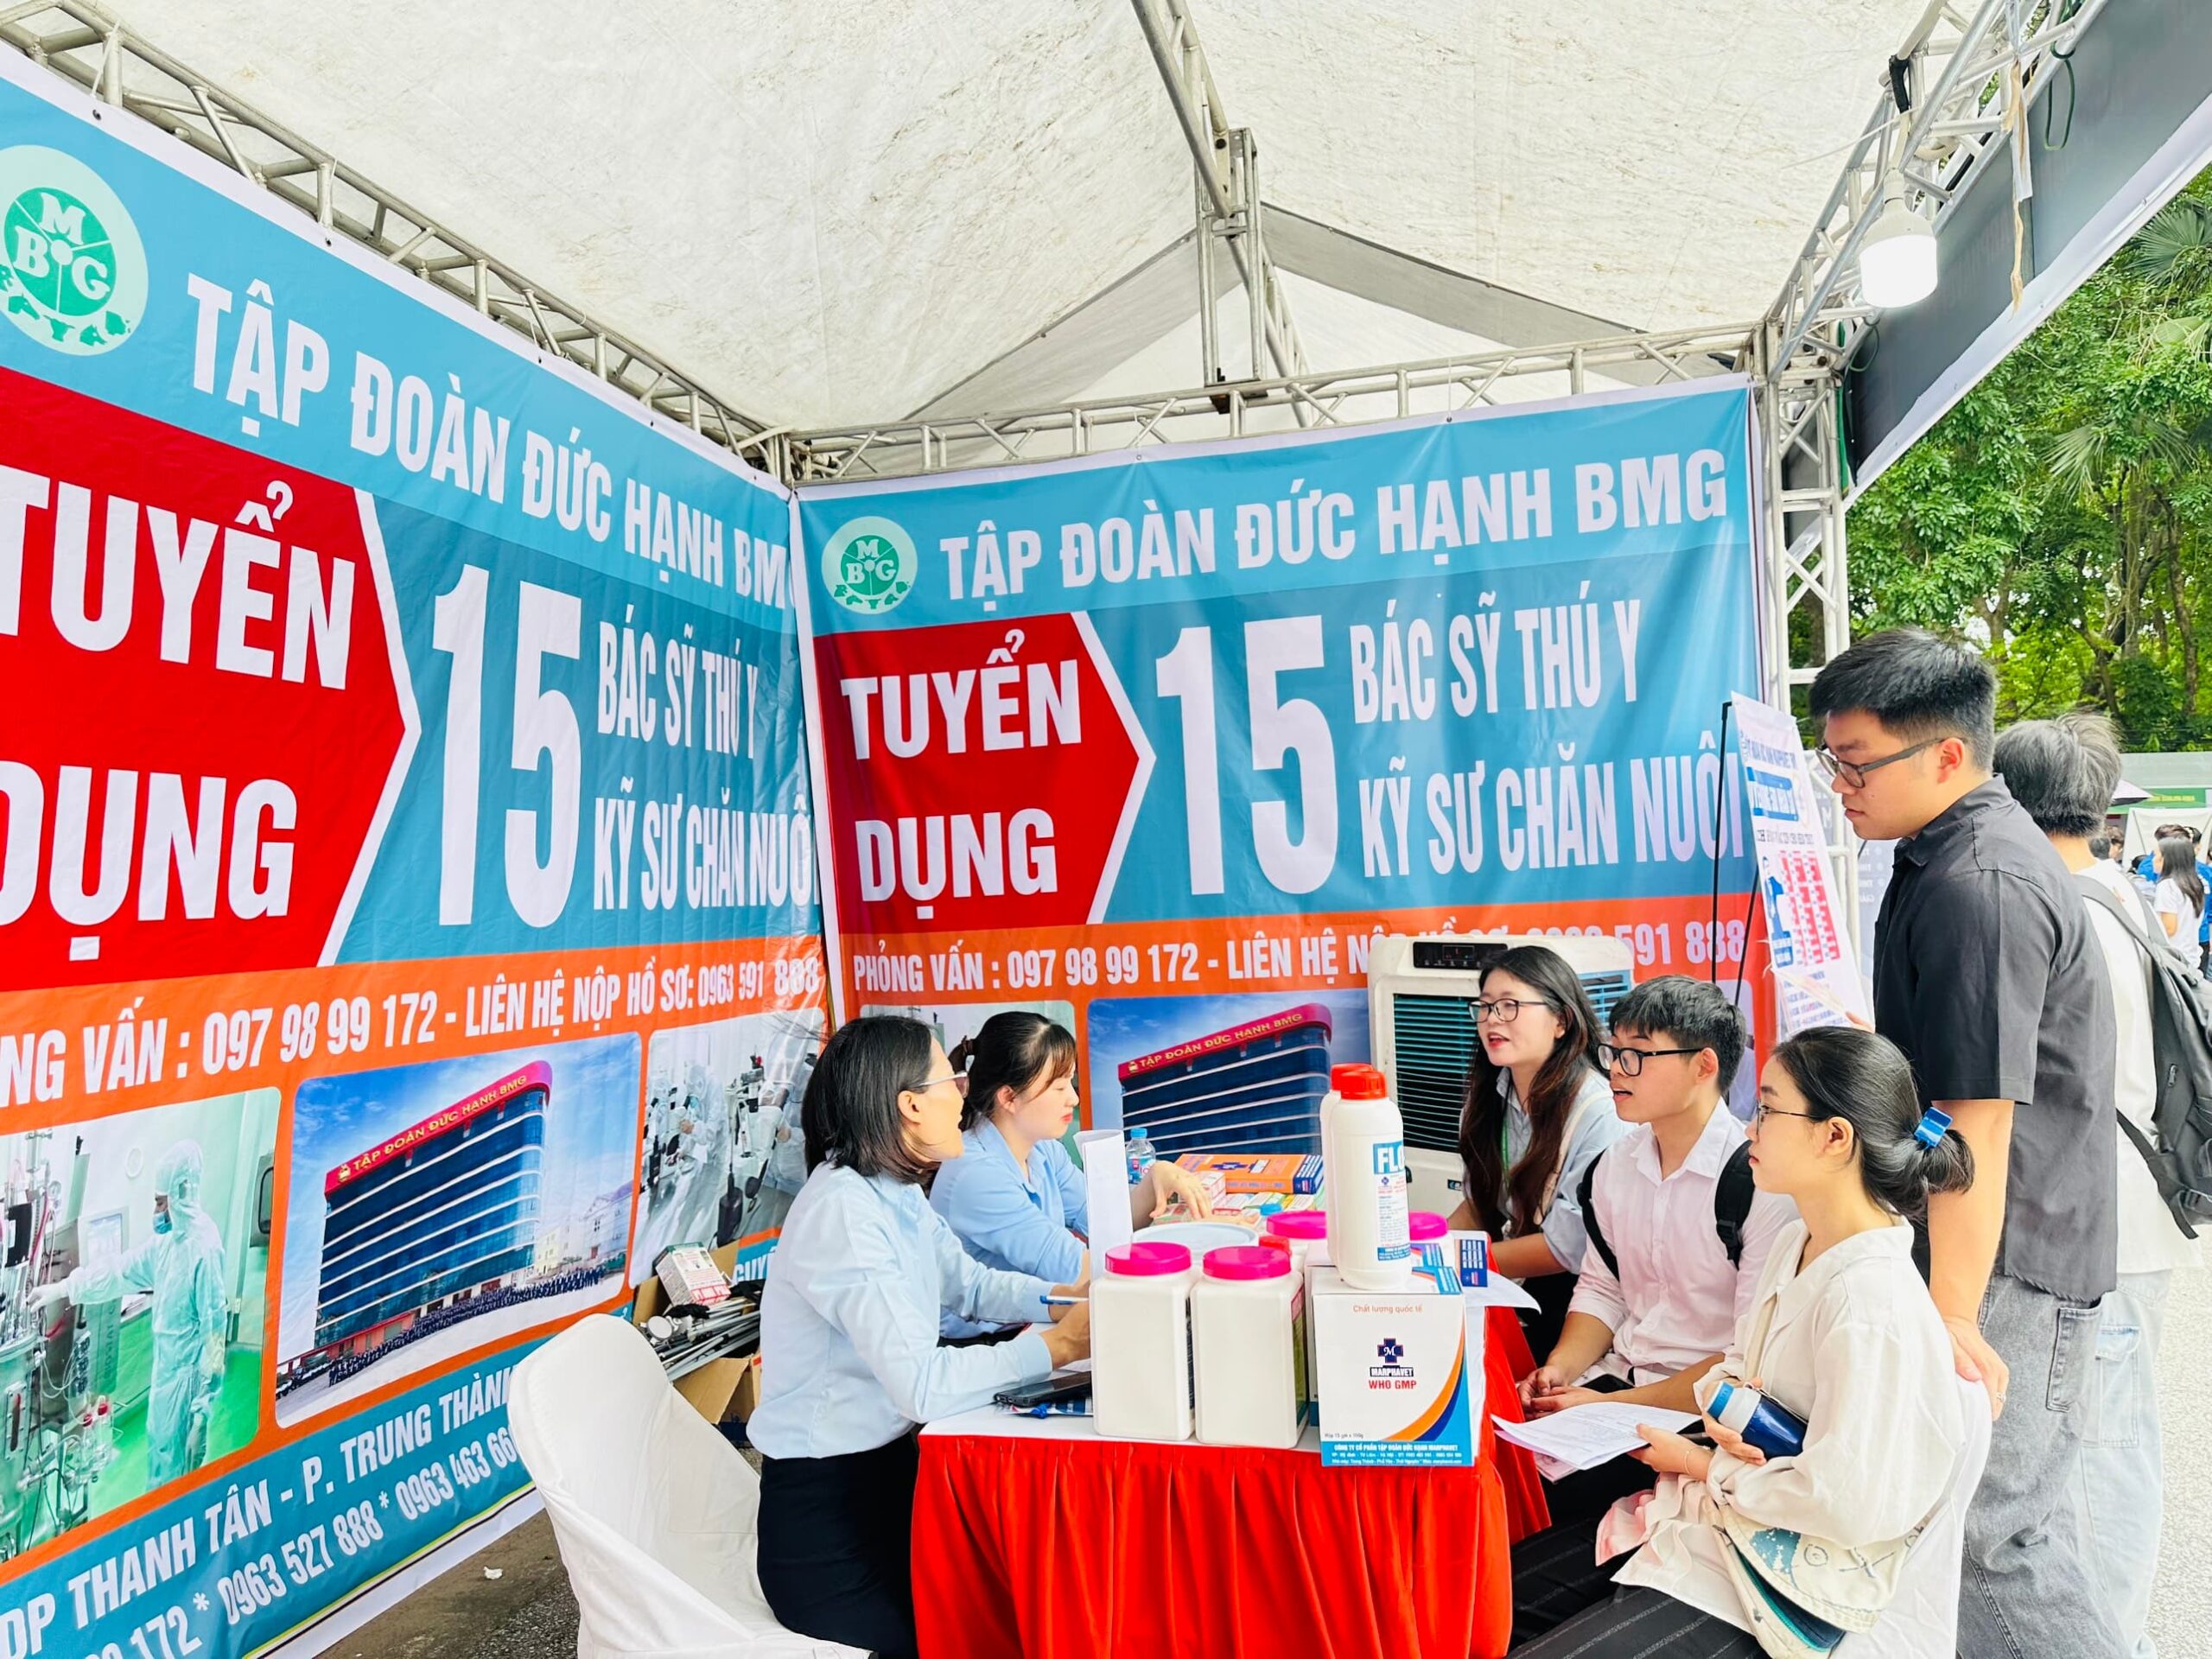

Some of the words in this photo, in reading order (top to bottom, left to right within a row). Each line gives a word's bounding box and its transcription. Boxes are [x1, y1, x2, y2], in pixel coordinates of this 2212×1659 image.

[187, 272, 331, 437] TẬP
[350, 351, 512, 505] ĐOÀN
[523, 426, 612, 543] ĐỨC
[625, 478, 723, 583] HẠNH
[734, 528, 795, 610] BM
[0, 464, 355, 690] TUYỂN
[939, 519, 1042, 612] TẬP
[1059, 499, 1216, 588] ĐOÀN
[1234, 478, 1356, 570] ĐỨC
[1376, 467, 1553, 566] HẠNH
[1574, 448, 1727, 535] BMG
[597, 603, 657, 742] BÁC
[664, 623, 696, 747] SỸ
[702, 639, 741, 757] THÚ
[747, 664, 759, 760] Y
[840, 629, 1083, 760] TUYỂN
[1350, 599, 1436, 725] BÁC
[1448, 590, 1502, 718] SỸ
[1514, 580, 1602, 711] THÚ
[1612, 599, 1641, 703] Y
[433, 563, 582, 928] 15
[1154, 614, 1339, 896] 15
[1358, 755, 1412, 879] KỸ
[1426, 760, 1486, 875] SƯ
[1496, 741, 1619, 873] CHĂN
[1630, 730, 1744, 863] NUÔI
[594, 776, 636, 911] KỸ
[641, 793, 683, 911] SƯ
[686, 787, 745, 910] CHĂN
[855, 807, 1058, 920] DỤNG
[83, 996, 168, 1094] VẤN
[202, 1007, 273, 1076] 097
[280, 1001, 320, 1063] 98
[327, 996, 371, 1055] 99
[383, 990, 438, 1048] 172
[465, 973, 526, 1038] LIÊN
[532, 969, 565, 1038] HỆ
[573, 966, 620, 1031] NỘP
[626, 956, 657, 1017] HỒ
[697, 963, 734, 1007] 0963
[739, 961, 764, 1001] 591
[774, 957, 819, 996] 888
[854, 939, 925, 993] PHỎNG
[929, 939, 985, 992] VẤN
[1007, 949, 1056, 990] 097
[1065, 946, 1098, 987] 98
[1105, 944, 1140, 985] 99
[1147, 942, 1200, 982] 172
[1226, 931, 1292, 981] LIÊN
[1300, 927, 1338, 985] HỆ
[1684, 918, 1745, 964] 888
[1274, 1013, 1303, 1027] BMG
[499, 1075, 527, 1095] BMG
[1368, 1380, 1392, 1389] WHO
[1395, 1380, 1417, 1389] GMP
[67, 1518, 196, 1630] THANH
[204, 1478, 272, 1554] TÂN
[302, 1456, 335, 1504] P.
[340, 1403, 432, 1486] TRUNG
[217, 1554, 287, 1625] 0963
[281, 1524, 335, 1588] 527
[333, 1500, 384, 1555] 888
[395, 1462, 452, 1522] 0963
[448, 1440, 492, 1490] 463
[486, 1425, 518, 1469] 66
